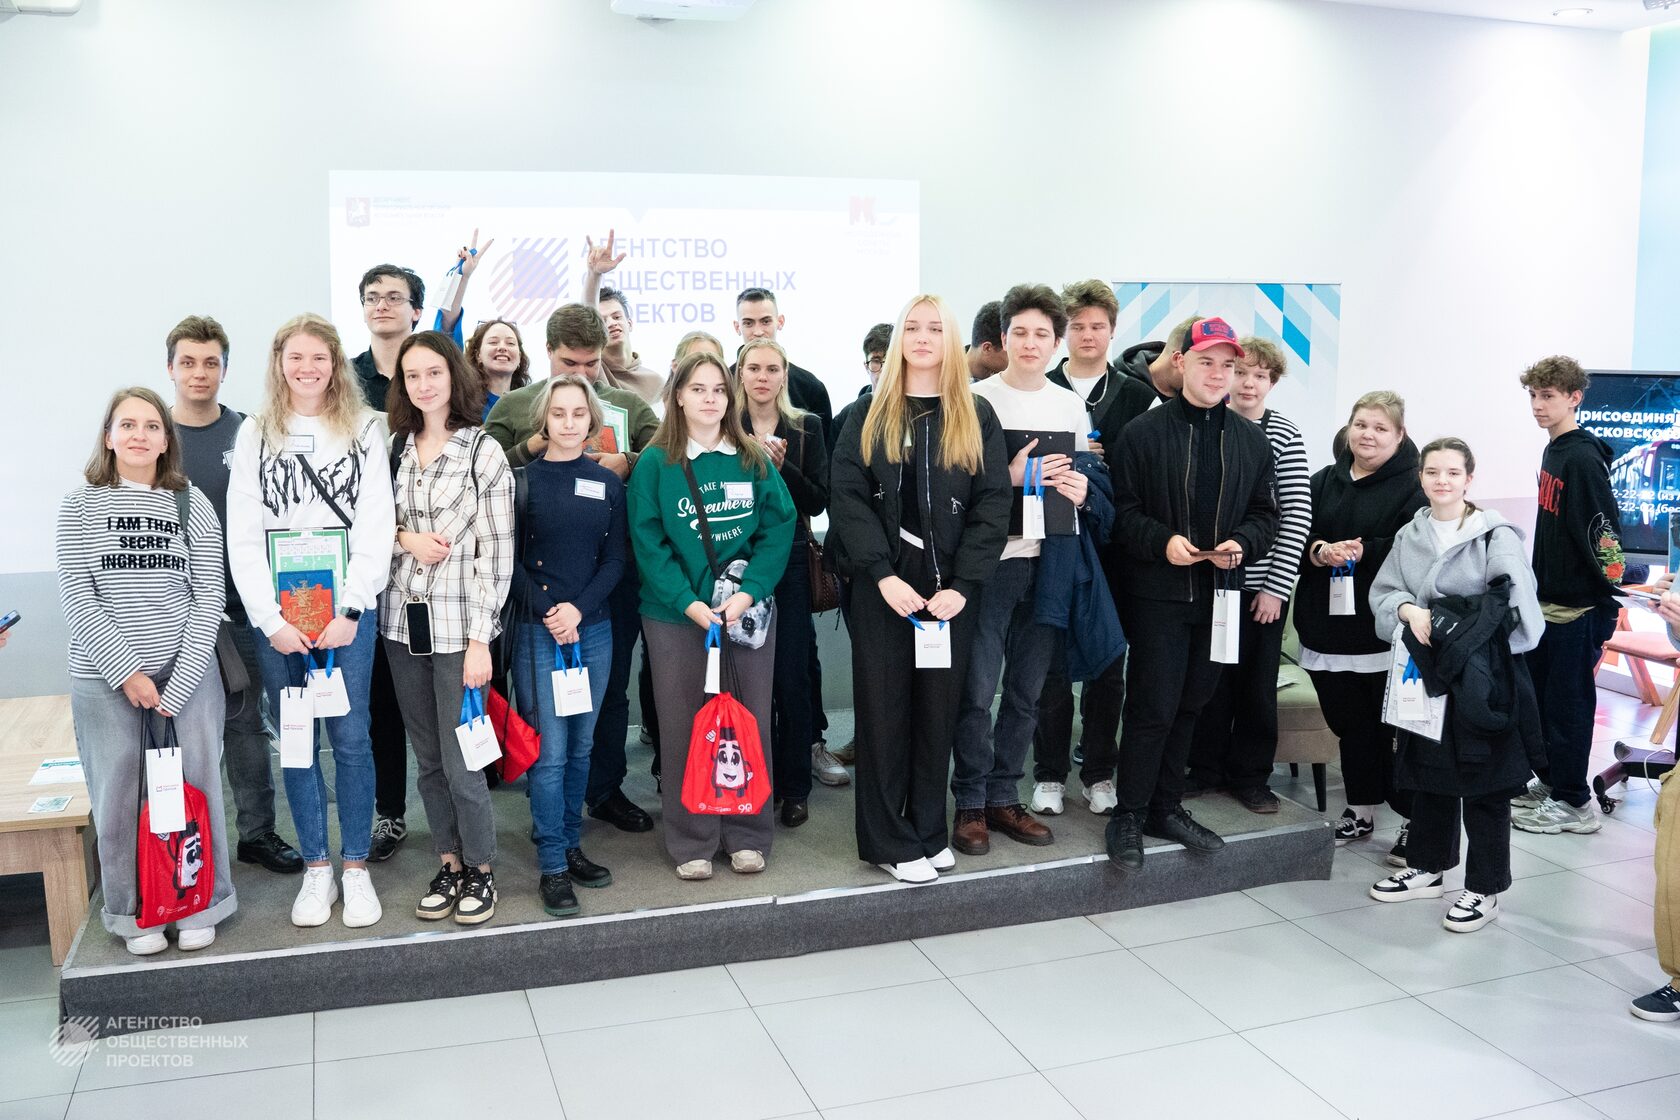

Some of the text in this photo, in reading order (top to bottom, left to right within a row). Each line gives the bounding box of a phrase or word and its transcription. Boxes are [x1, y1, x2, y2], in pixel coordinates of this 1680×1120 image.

[581, 270, 797, 293] БЩЕСТВЕННЫХ
[677, 497, 755, 518] Soewhere
[107, 516, 181, 536] I AM THAT
[119, 536, 171, 550] SECRET
[101, 553, 187, 572] INGREDIENT
